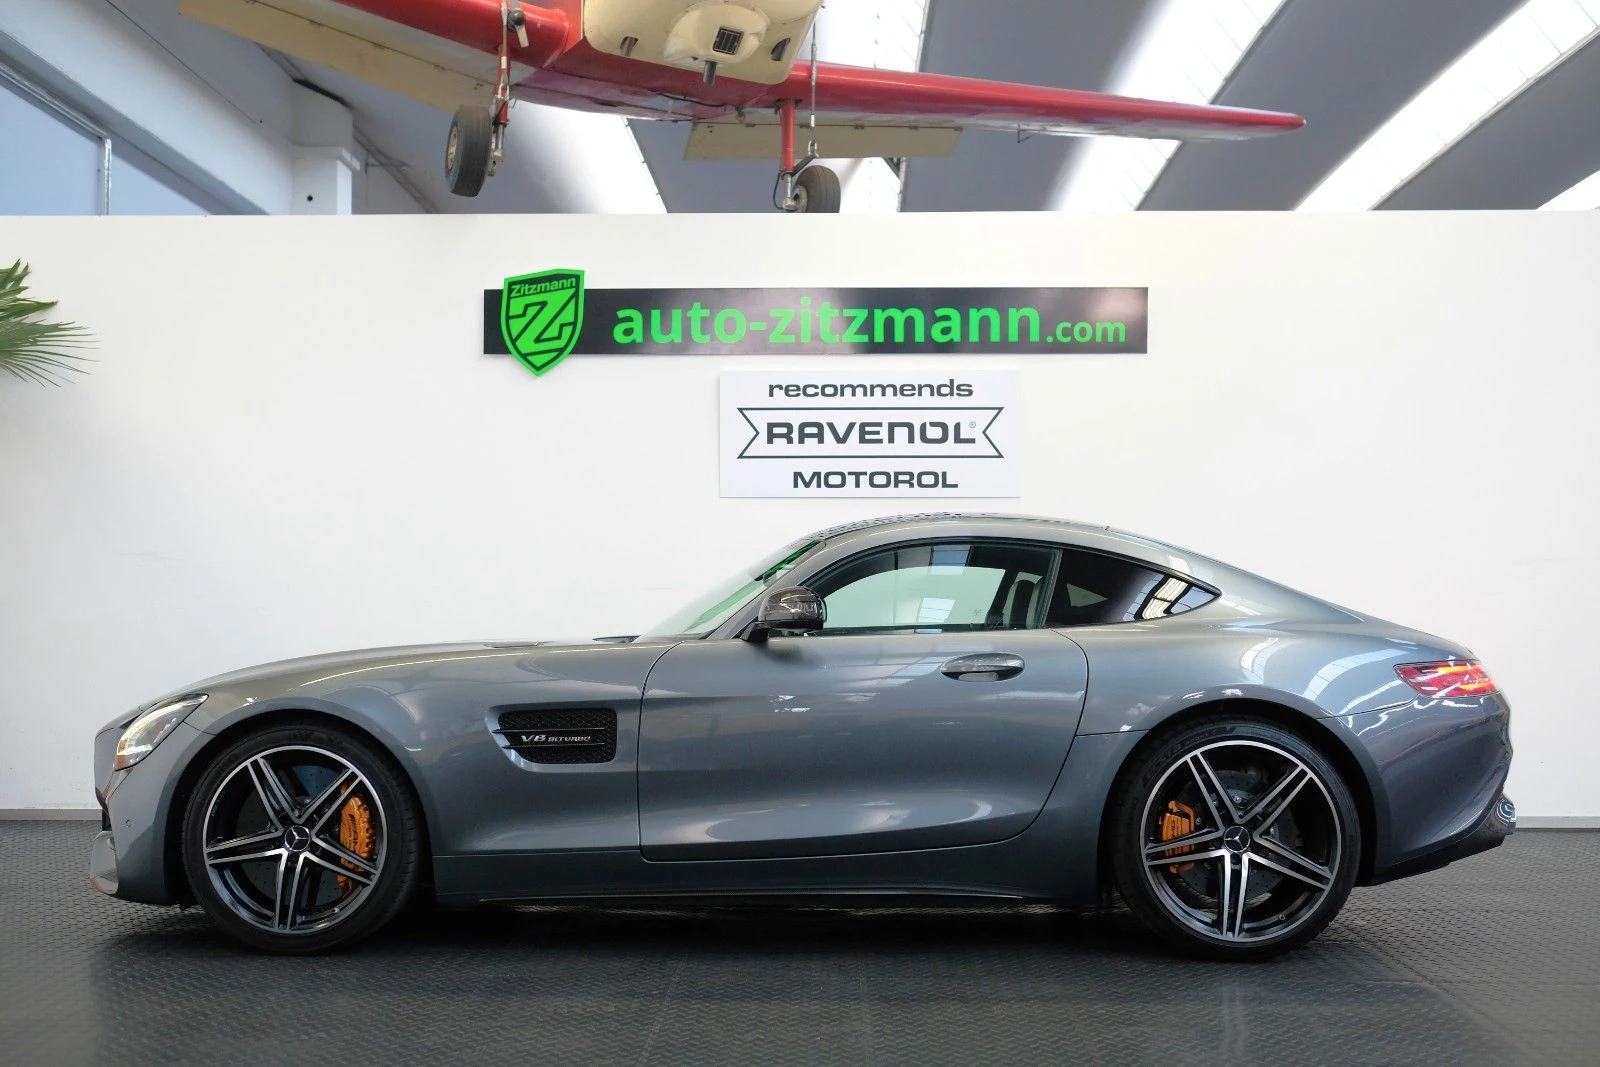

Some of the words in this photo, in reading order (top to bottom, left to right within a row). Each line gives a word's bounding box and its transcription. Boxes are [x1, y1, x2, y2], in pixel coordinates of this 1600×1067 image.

[511, 278, 576, 297] Zitzmann
[613, 297, 1126, 343] auto-zitzmann.com
[768, 379, 974, 398] recommends
[793, 471, 959, 489] MOTOROL
[521, 734, 547, 742] V8
